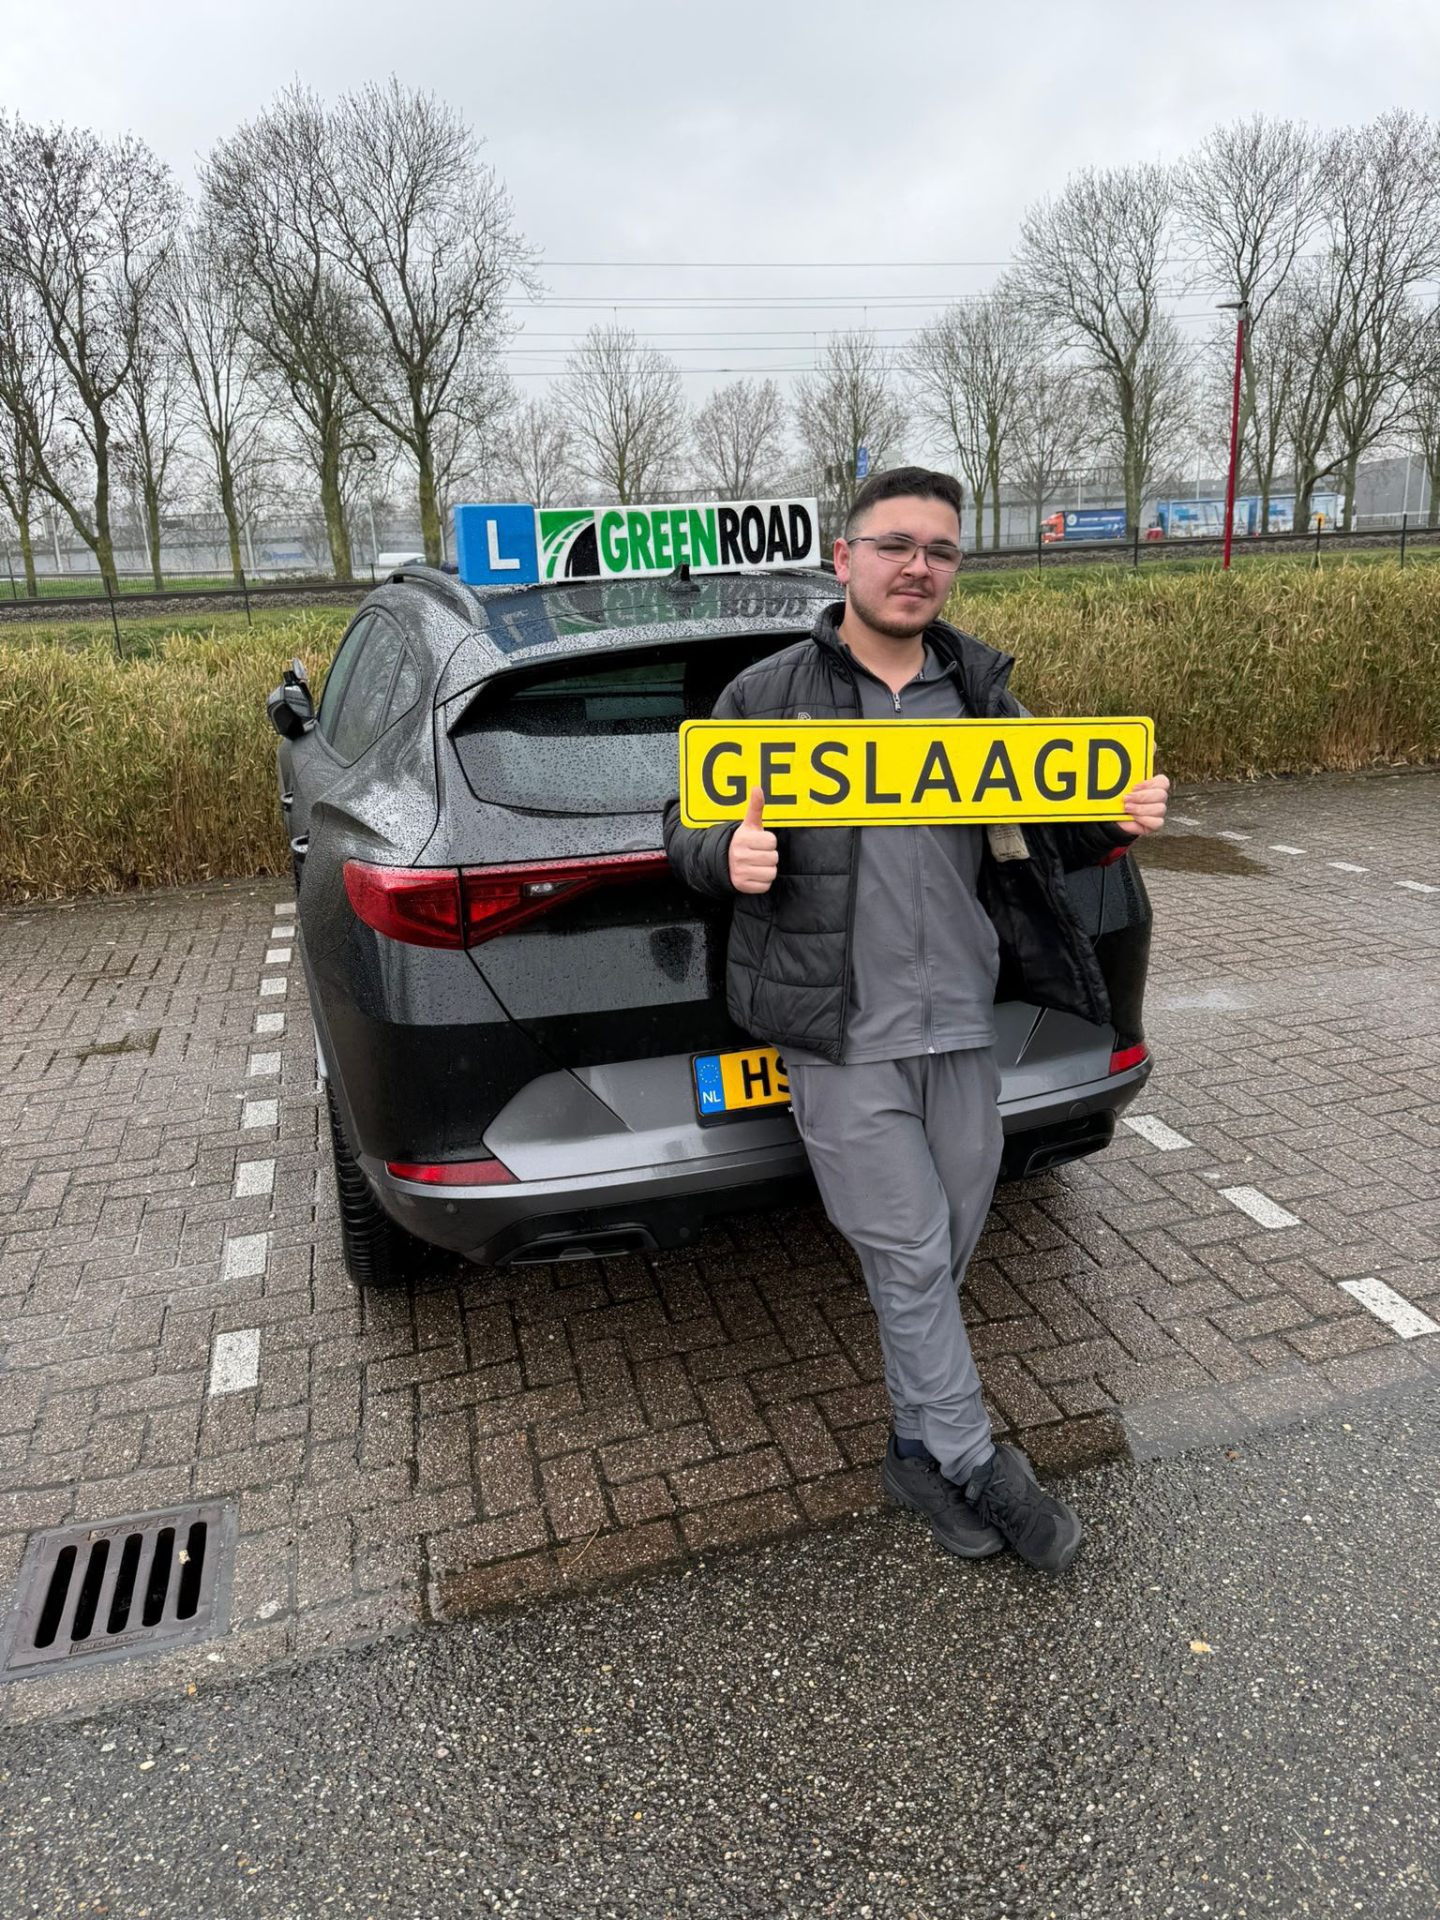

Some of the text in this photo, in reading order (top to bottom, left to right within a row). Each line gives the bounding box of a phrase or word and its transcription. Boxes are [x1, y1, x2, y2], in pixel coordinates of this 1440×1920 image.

[487, 520, 521, 570] L
[701, 739, 1132, 806] GESLAAGD
[702, 1090, 721, 1104] NL
